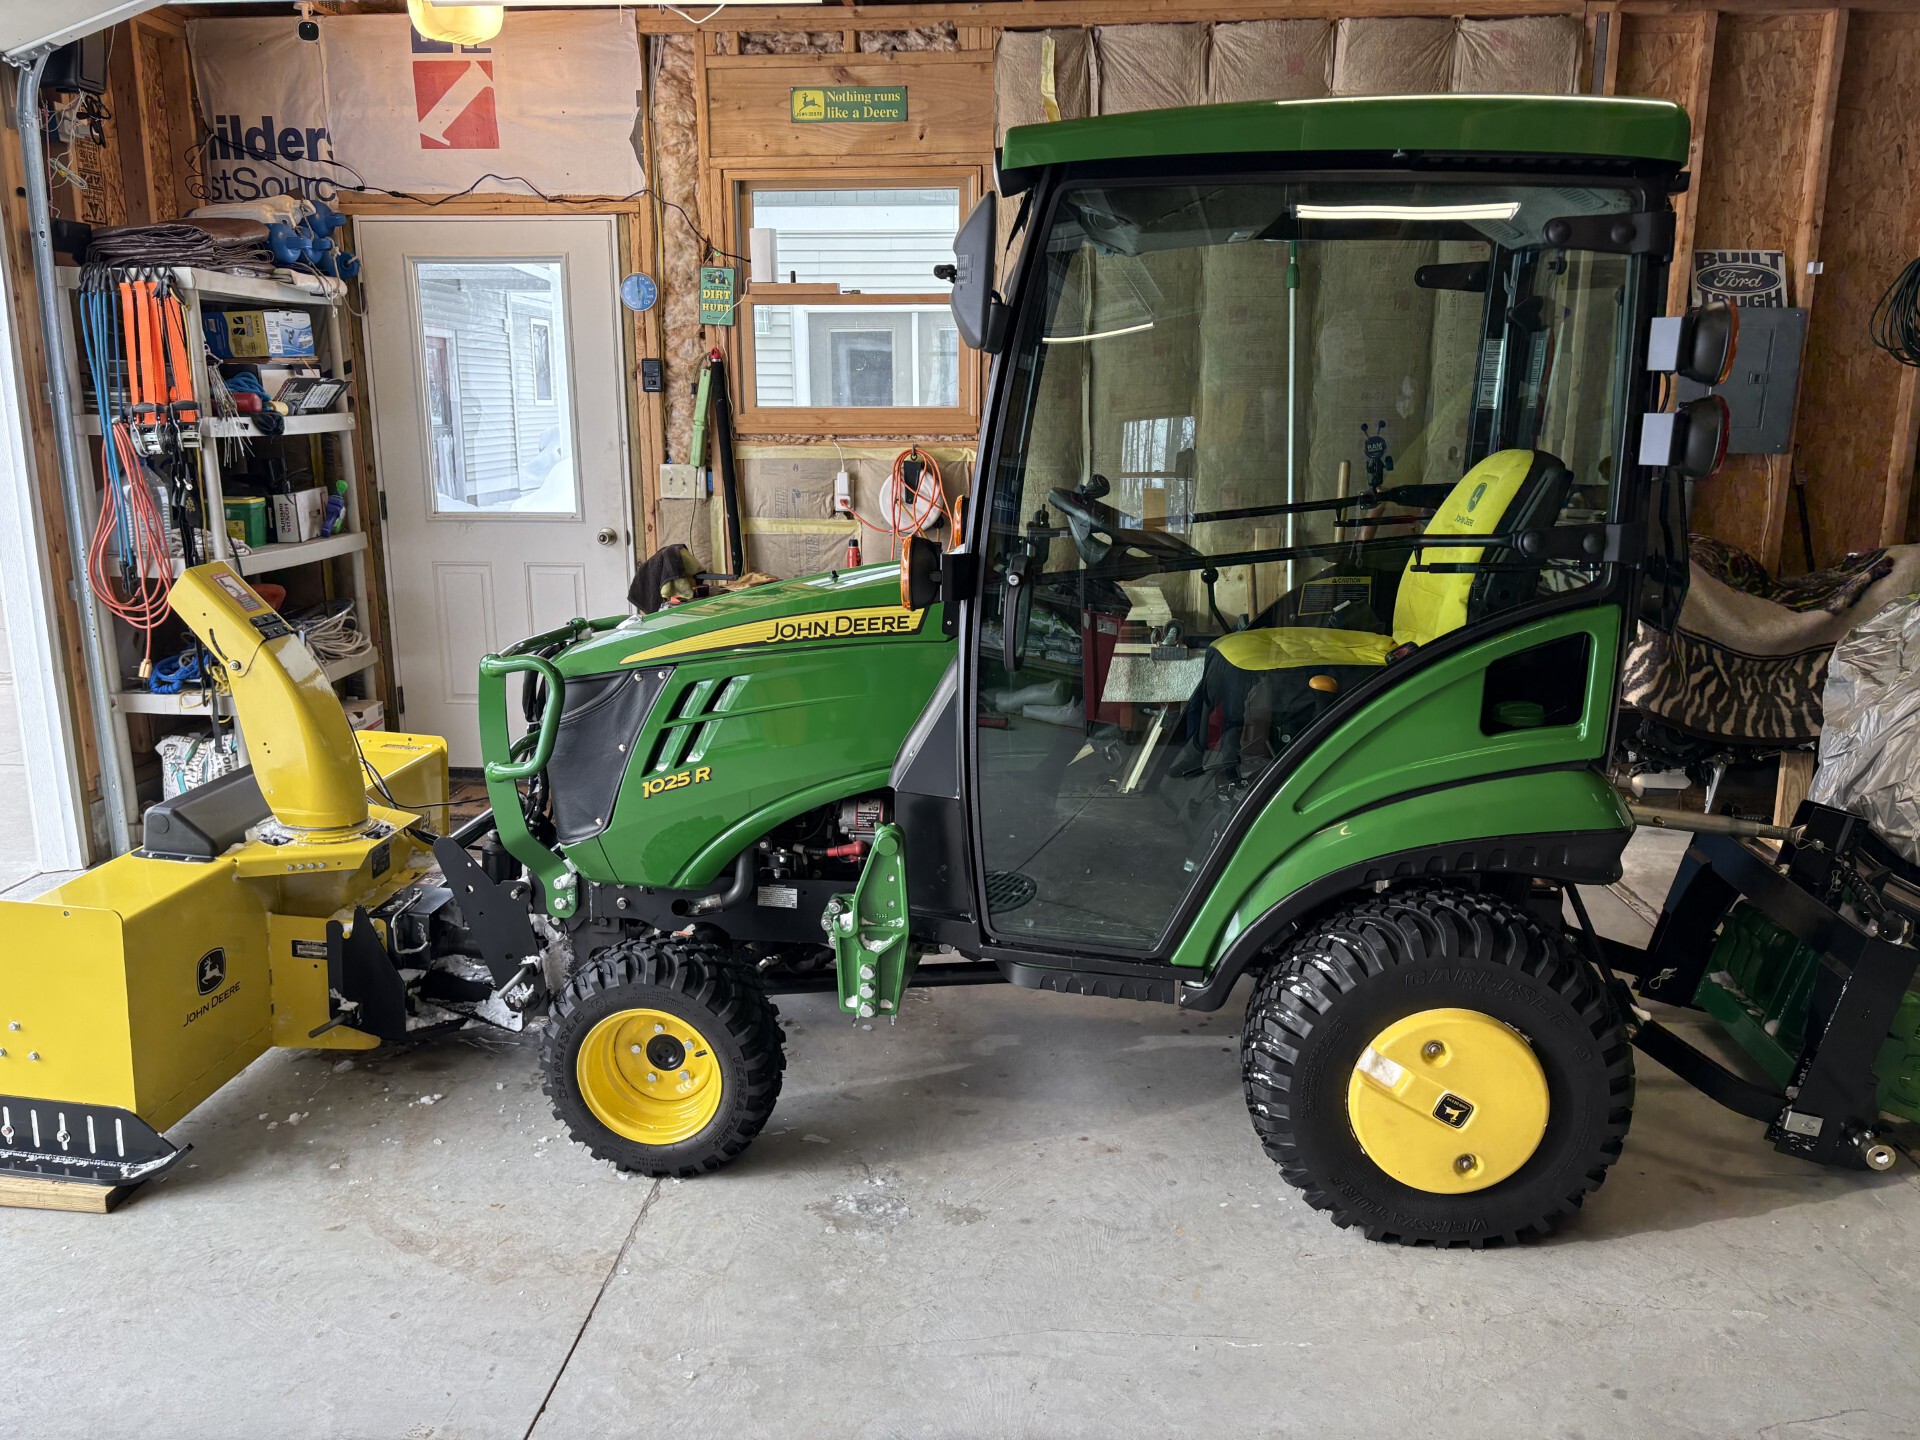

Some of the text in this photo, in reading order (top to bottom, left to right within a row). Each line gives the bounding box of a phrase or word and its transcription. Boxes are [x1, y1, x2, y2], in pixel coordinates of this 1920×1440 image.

[827, 91, 901, 104] Nothing runs
[827, 106, 899, 118] like a Deere
[1695, 252, 1784, 272] BUILT
[1714, 268, 1763, 288] Ford
[702, 289, 732, 300] DIRT
[702, 303, 731, 313] HURT
[1367, 442, 1383, 452] RAM
[284, 503, 292, 533] HONDA
[766, 615, 910, 641] JOHN DEERE
[642, 766, 712, 799] 1025 R
[183, 981, 241, 1027] JOHN DEERE
[1405, 967, 1573, 1032] CARLISLE
[553, 1010, 585, 1100] CARLISLE
[1327, 1176, 1489, 1233] VERSA TURF
